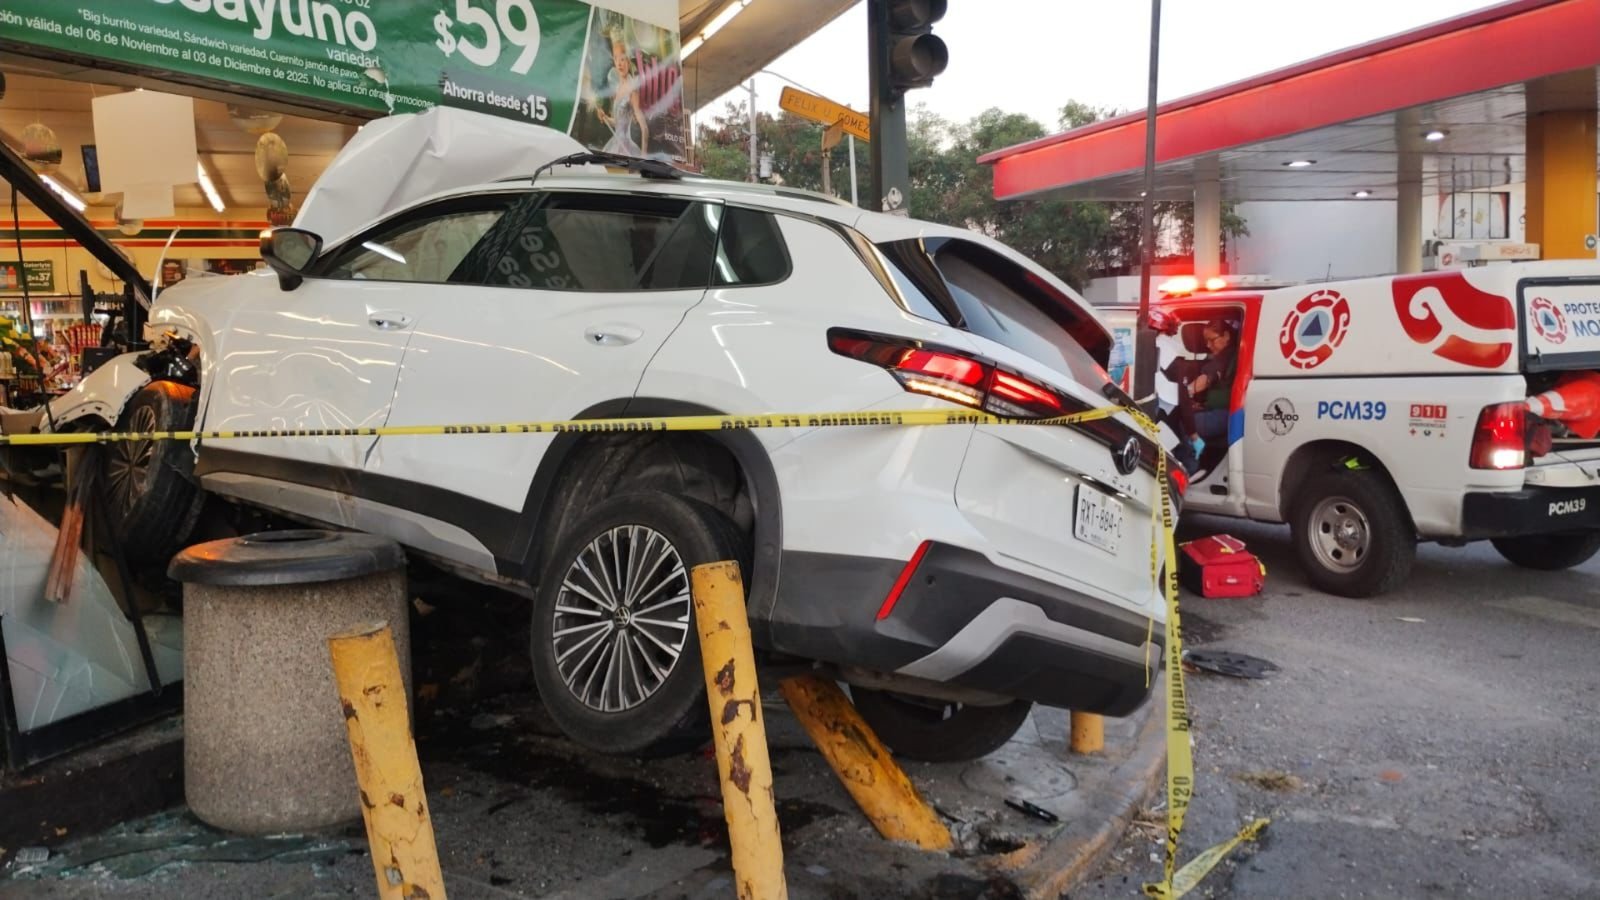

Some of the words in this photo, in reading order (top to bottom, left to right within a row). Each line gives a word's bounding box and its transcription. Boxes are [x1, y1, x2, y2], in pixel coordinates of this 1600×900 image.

[102, 13, 137, 31] burrito
[138, 22, 182, 41] variedad,
[183, 31, 228, 50] Sándwich
[229, 44, 268, 60] variedad,
[269, 50, 305, 67] Cuernito
[305, 57, 328, 73] jamón
[329, 64, 339, 75] de
[434, 0, 540, 75] $59
[25, 16, 62, 34] válida
[65, 24, 83, 38] del
[86, 28, 101, 41] 06
[103, 32, 118, 45] de
[121, 35, 179, 58] Noviembre
[181, 49, 191, 60] al
[193, 51, 206, 64] 03
[208, 54, 222, 67] de
[224, 56, 271, 76] Diciembre
[273, 67, 285, 79] de
[286, 70, 311, 85] 2025.
[313, 75, 326, 87] No
[327, 79, 352, 93] aplica
[352, 85, 368, 97] con
[443, 80, 485, 103] Ahorra
[488, 90, 521, 111] desde
[522, 94, 548, 121] $15
[787, 94, 817, 113] FELIX
[1317, 401, 1386, 421] PCM39
[1411, 405, 1446, 418] 911
[1548, 498, 1586, 517] PCM39
